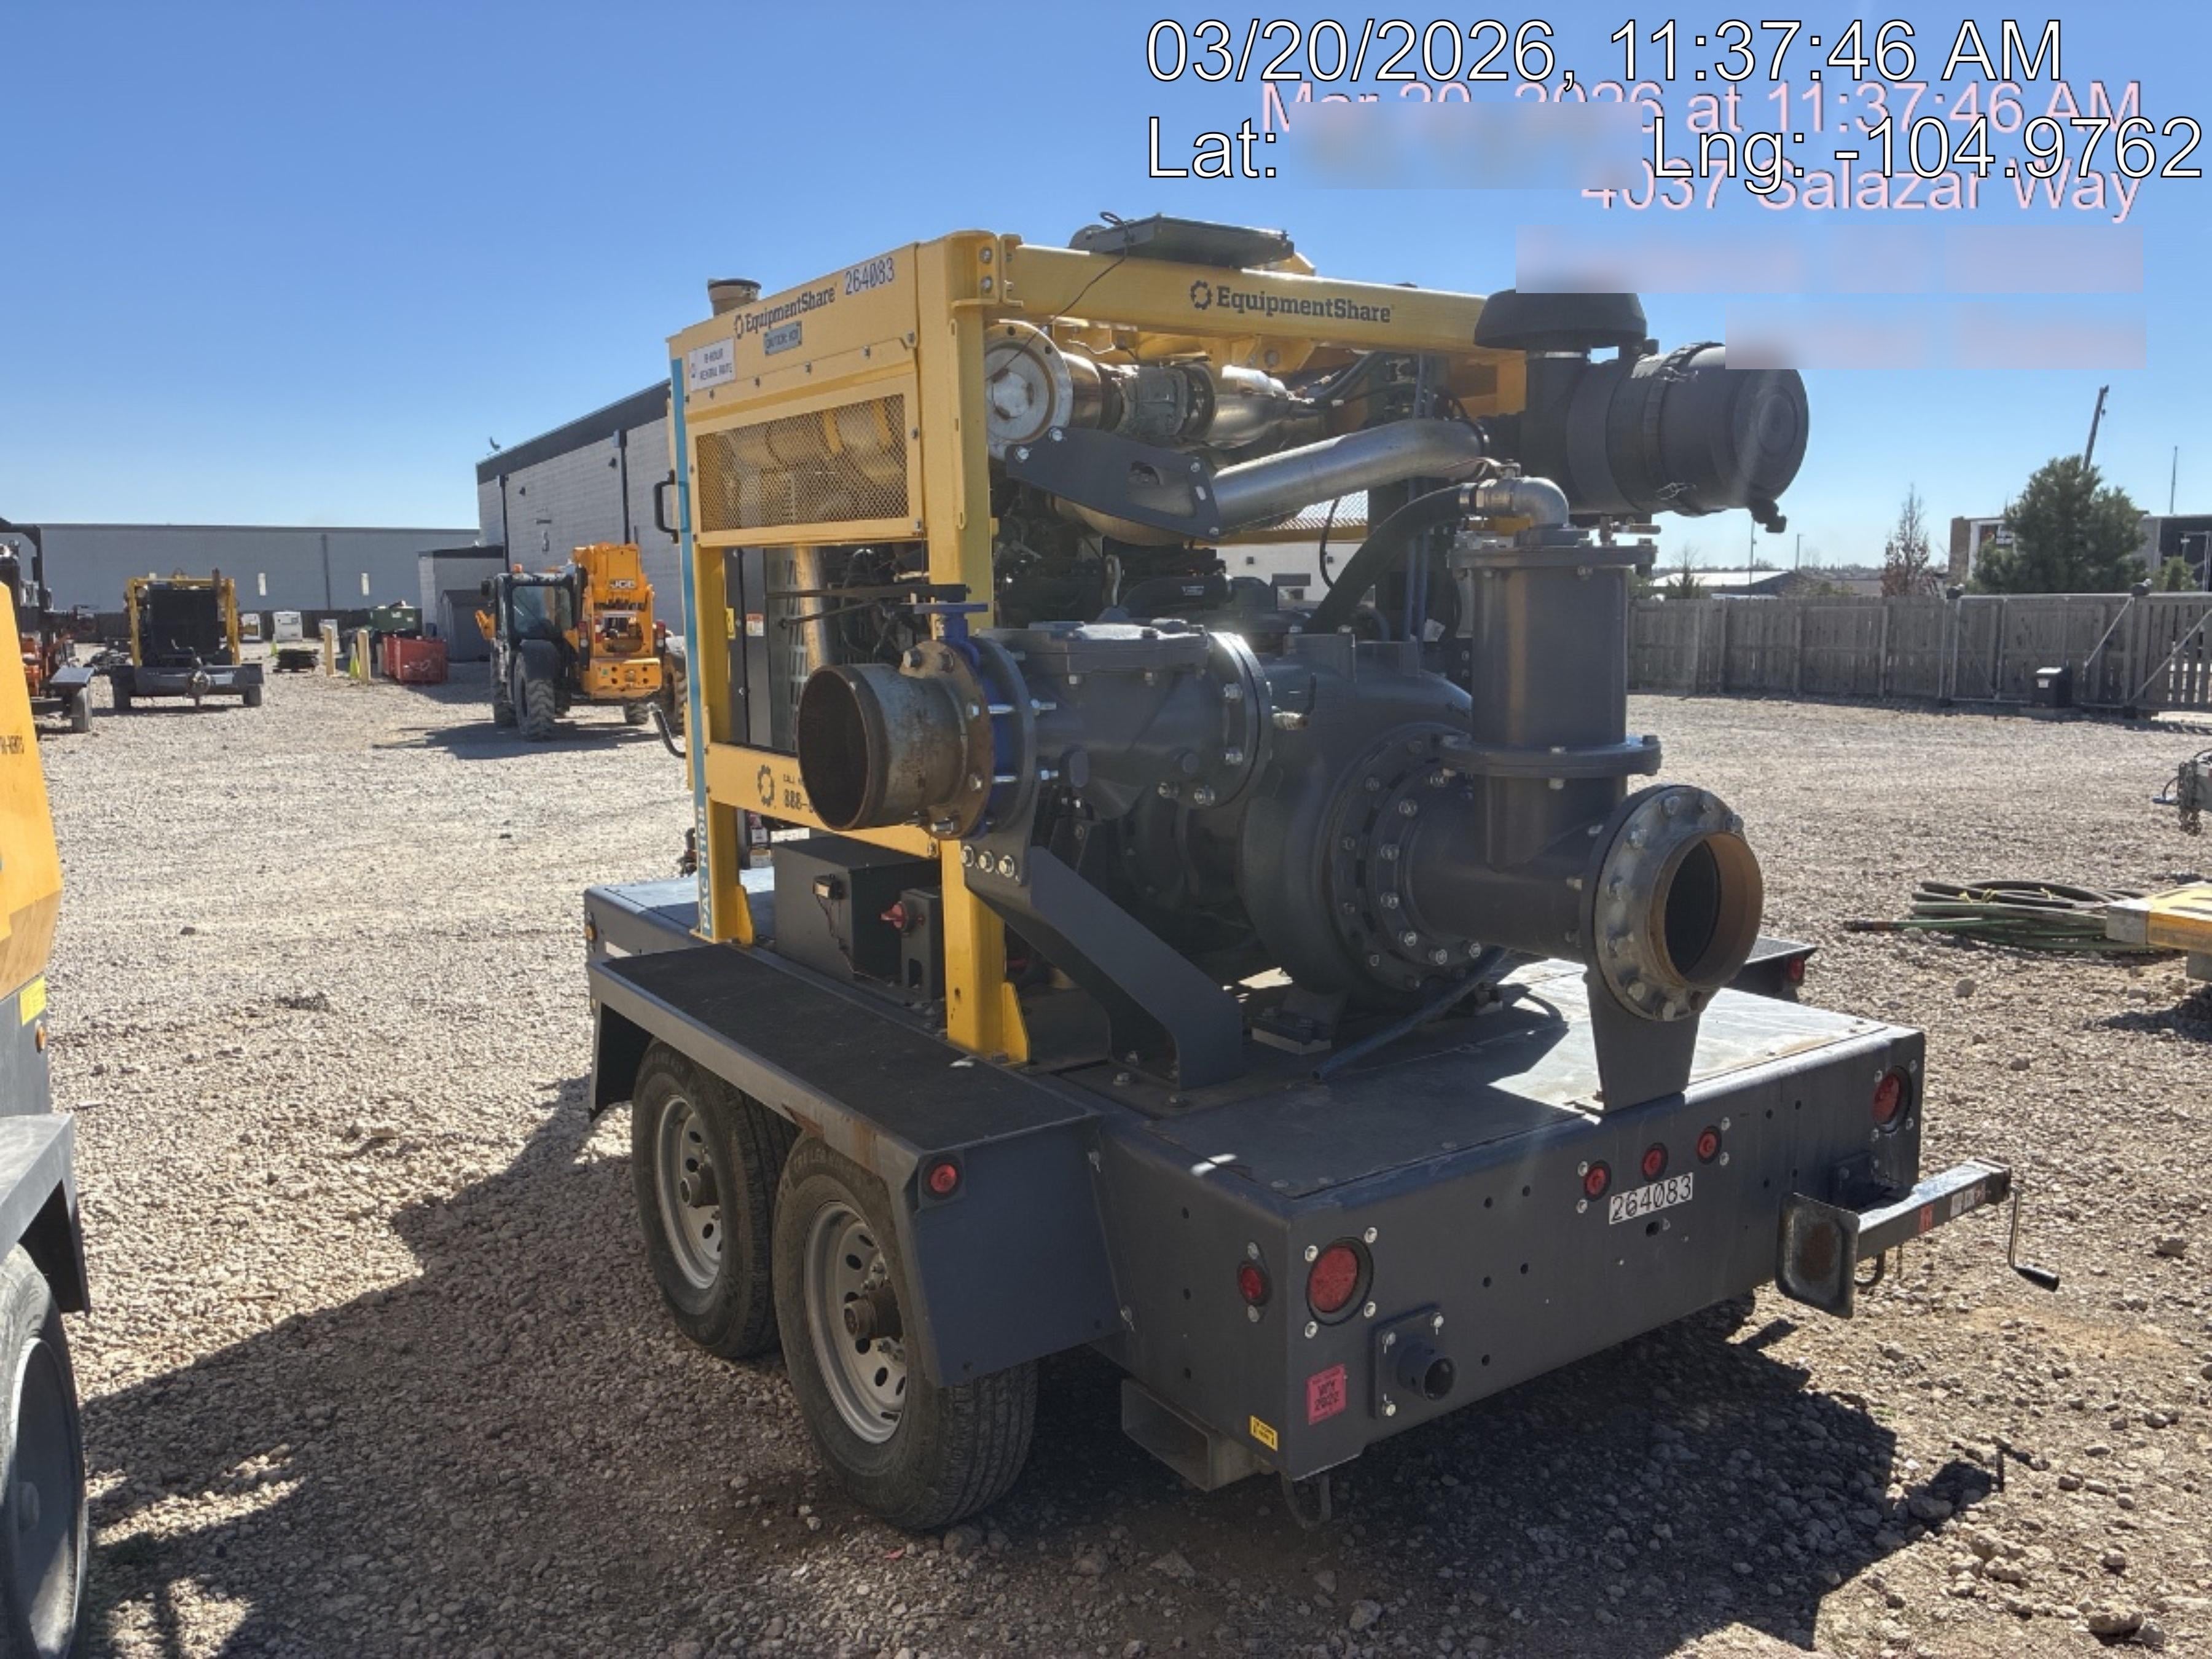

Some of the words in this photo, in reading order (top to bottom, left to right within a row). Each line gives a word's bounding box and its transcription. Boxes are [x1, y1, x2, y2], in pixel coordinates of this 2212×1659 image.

[844, 257, 895, 295] 264083
[744, 286, 836, 334] EquipmentShare
[1216, 285, 1391, 323] EquipmentShare
[1611, 1175, 1691, 1221] 264083
